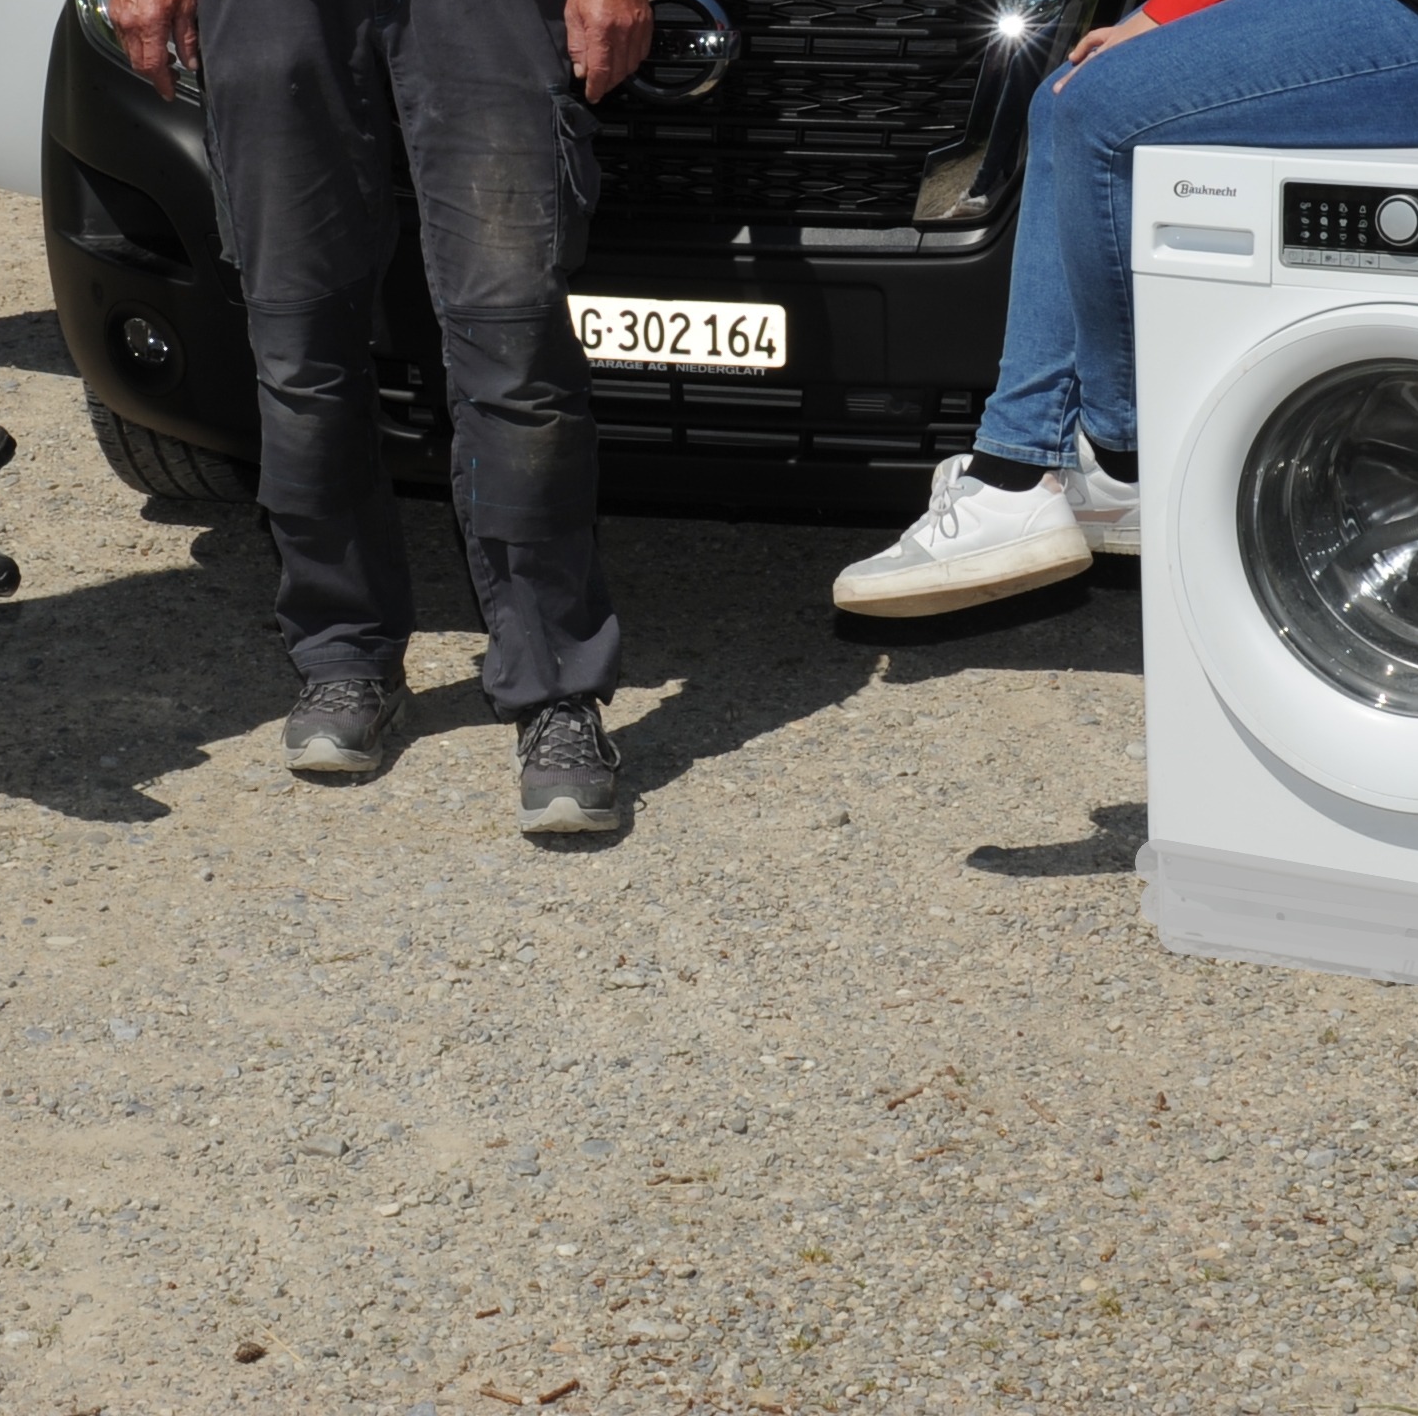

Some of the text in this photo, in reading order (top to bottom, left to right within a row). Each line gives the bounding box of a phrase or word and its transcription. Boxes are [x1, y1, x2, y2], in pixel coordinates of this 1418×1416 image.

[1179, 182, 1237, 198] Bauknecht
[703, 313, 777, 360] 164
[647, 362, 668, 372] AG
[675, 364, 767, 377] NIEDERGLATT
